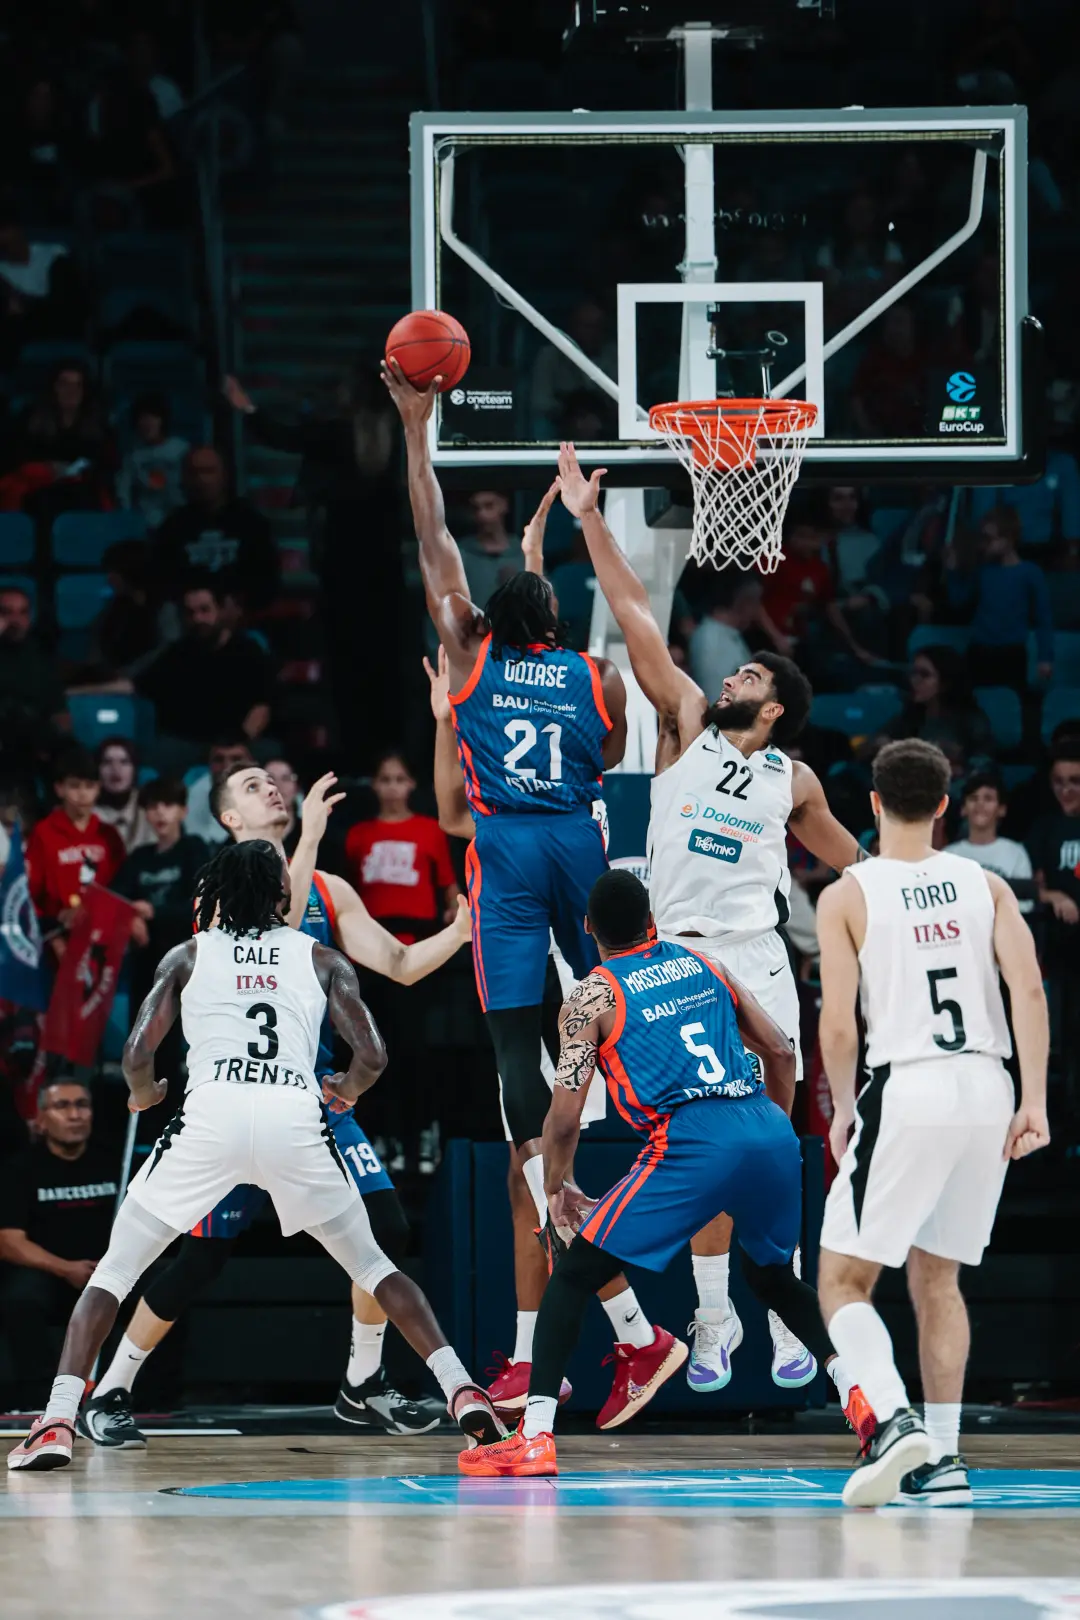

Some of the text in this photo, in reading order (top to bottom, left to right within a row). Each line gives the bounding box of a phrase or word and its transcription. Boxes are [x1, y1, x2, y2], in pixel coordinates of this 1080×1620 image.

[467, 395, 512, 404] oneteam
[939, 421, 984, 433] EuroCup
[504, 659, 568, 689] ODIASE
[492, 694, 529, 710] BAU
[503, 719, 562, 780] 21
[715, 760, 754, 801] 22
[762, 763, 786, 775] oneteam
[702, 806, 765, 835] Dolomiti
[694, 835, 737, 857] TRENTINO
[719, 826, 760, 844] energia
[901, 881, 957, 911] FORD
[913, 919, 961, 943] ITAS
[233, 945, 280, 965] CALE
[236, 975, 278, 990] ITAS
[621, 956, 703, 995] MASSINBURG
[641, 1001, 677, 1023] BAU
[926, 966, 967, 1051] 5
[245, 1002, 279, 1061] 3
[679, 1021, 726, 1085] 5
[344, 1142, 382, 1177] 19
